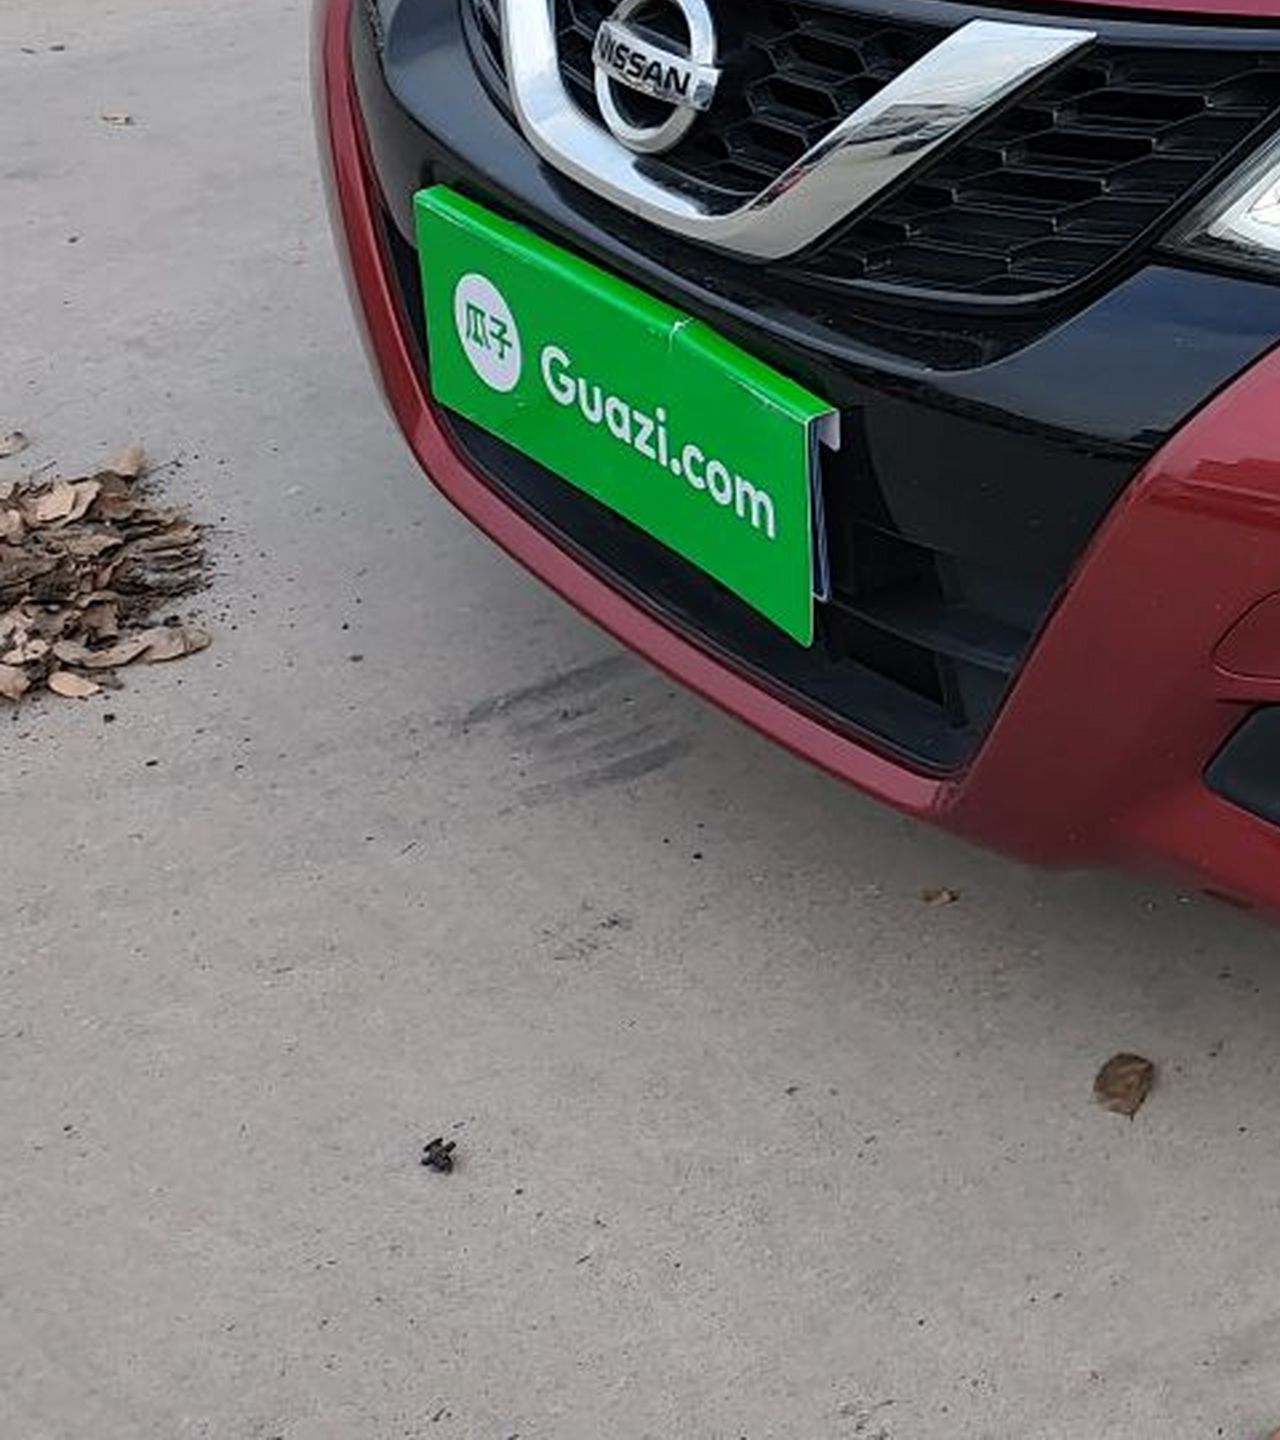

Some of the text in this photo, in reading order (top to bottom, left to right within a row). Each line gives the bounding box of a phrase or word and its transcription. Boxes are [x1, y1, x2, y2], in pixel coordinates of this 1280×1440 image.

[599, 25, 692, 96] NISSAN
[466, 300, 513, 359] 瓜子
[540, 345, 776, 540] Guazi.com
